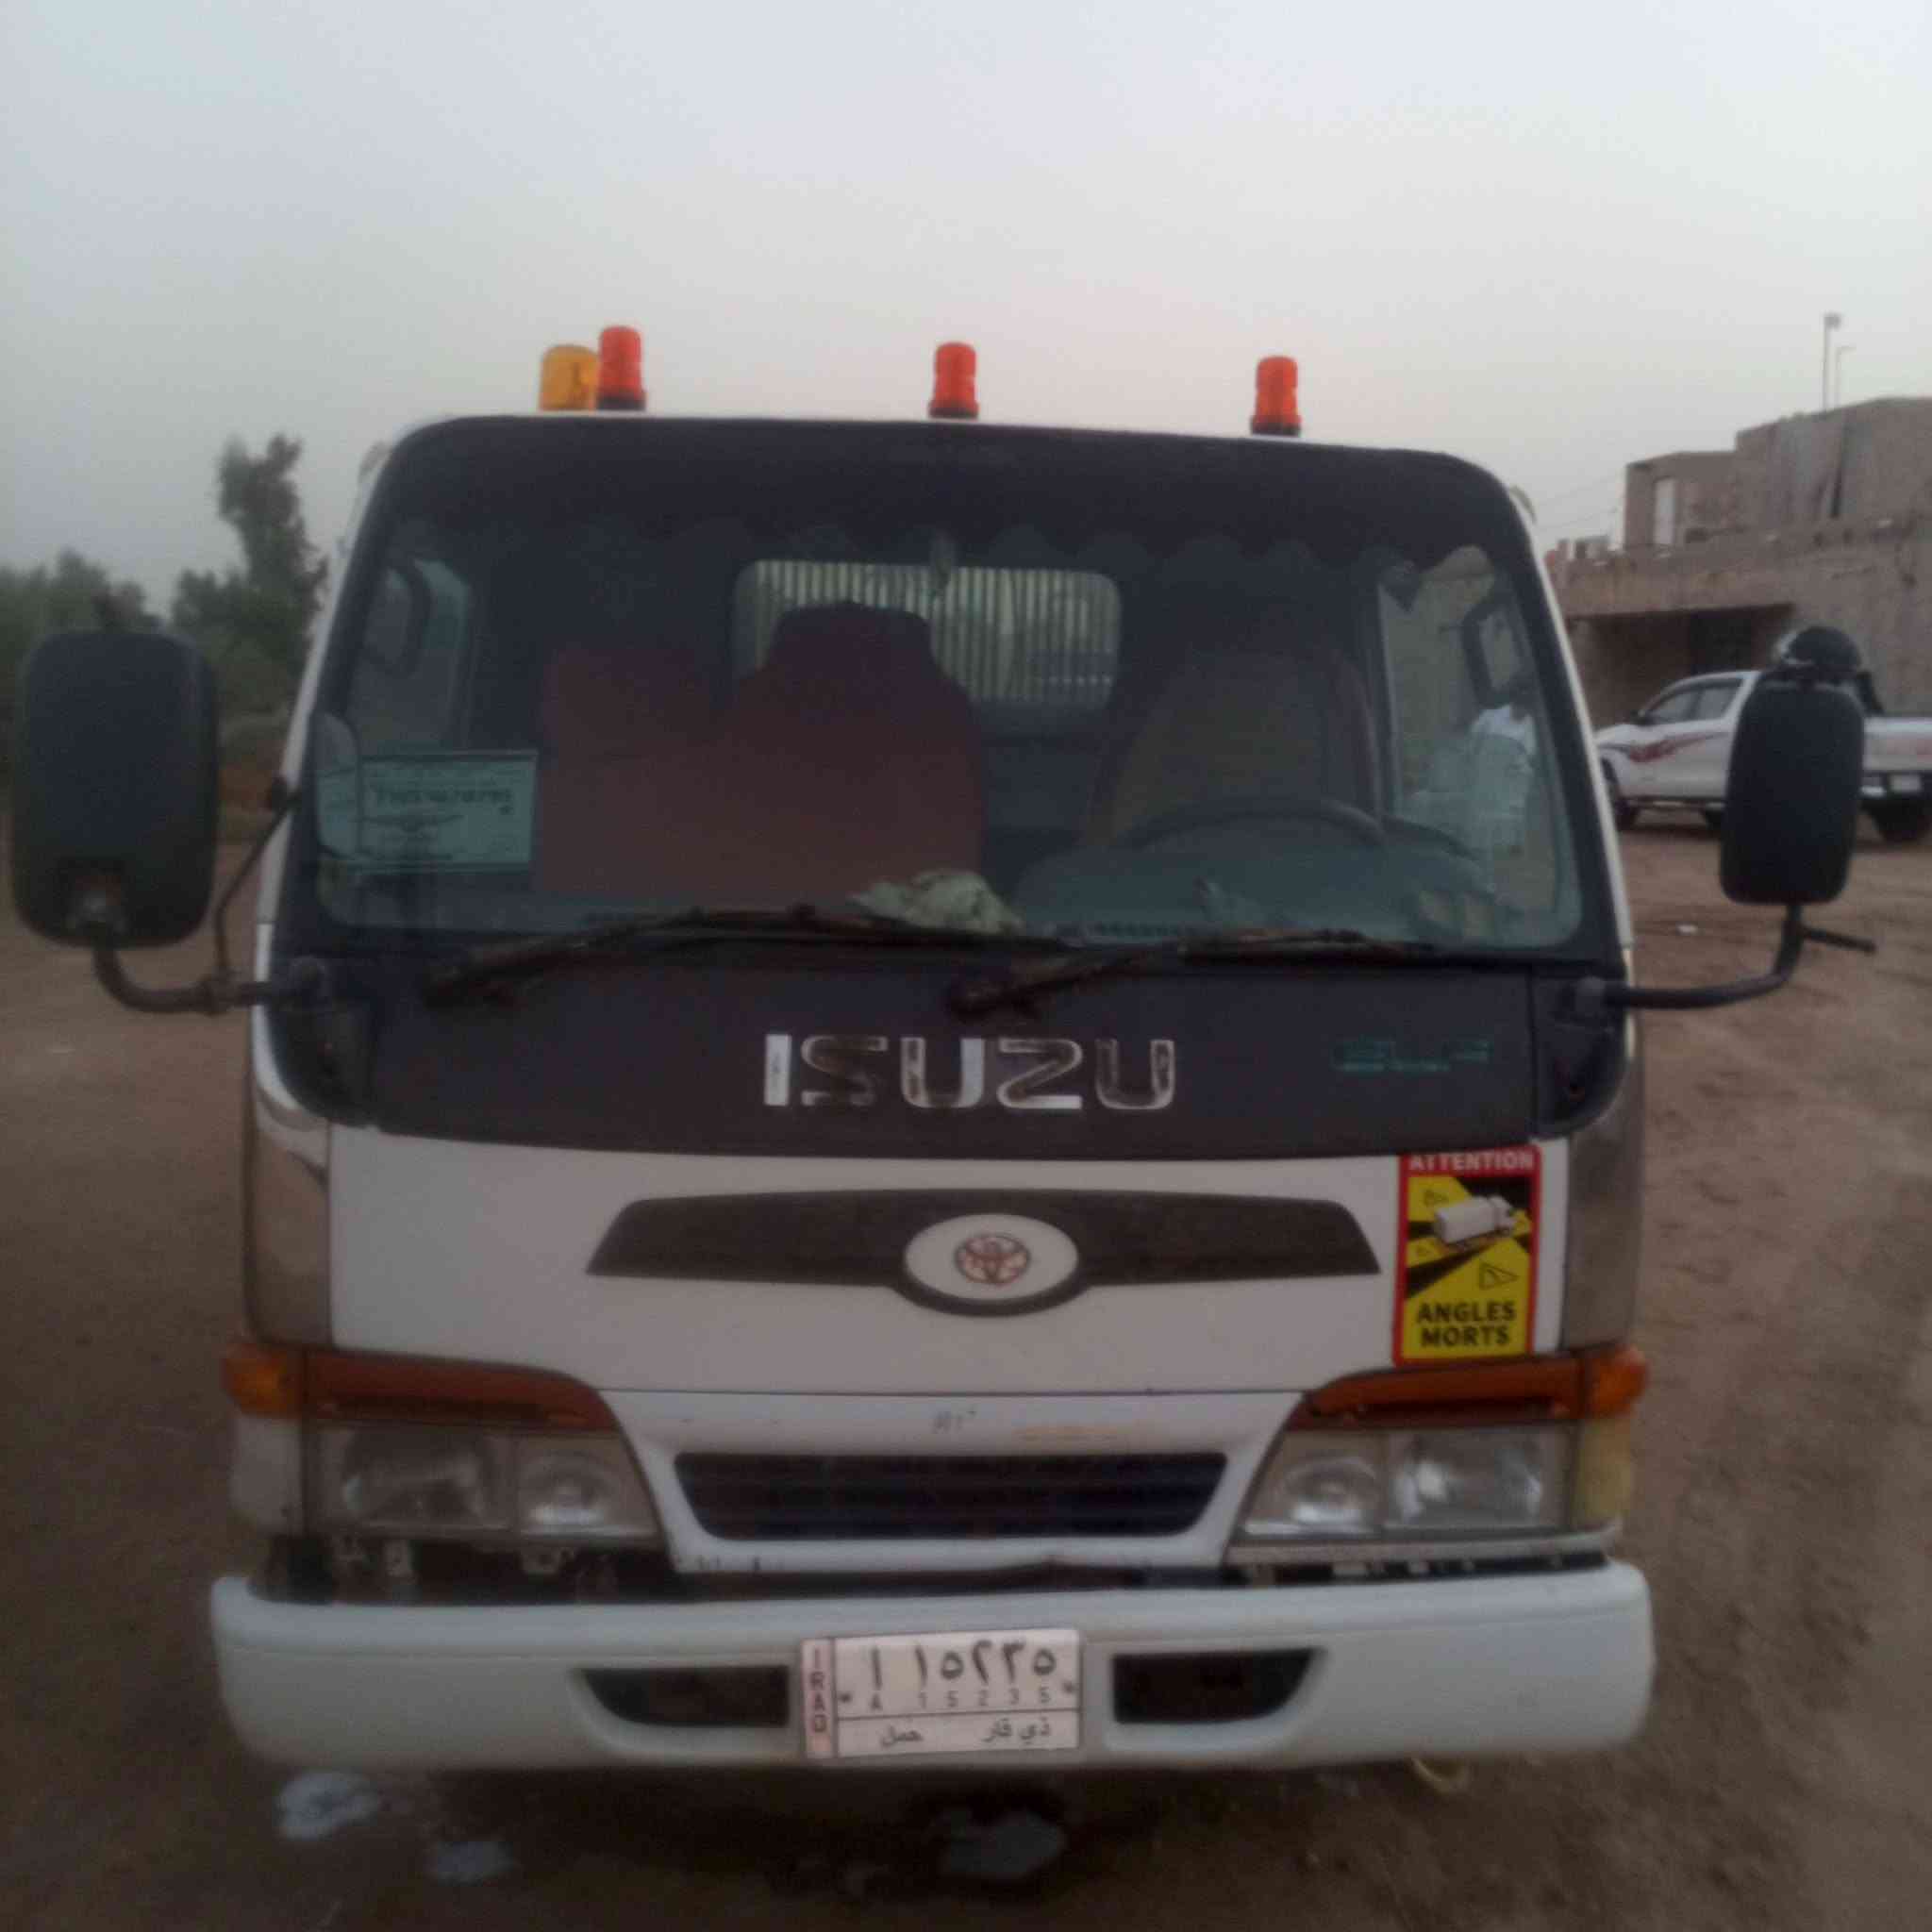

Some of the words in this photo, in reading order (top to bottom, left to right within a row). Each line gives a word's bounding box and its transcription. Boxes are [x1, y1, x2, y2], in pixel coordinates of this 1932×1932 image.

[763, 1034, 1177, 1110] ISUZU
[1407, 1149, 1535, 1172] ATTENTION
[1417, 1300, 1517, 1324] ANGLES
[1421, 1324, 1509, 1348] MORTS
[808, 1647, 827, 1734] IRAQ
